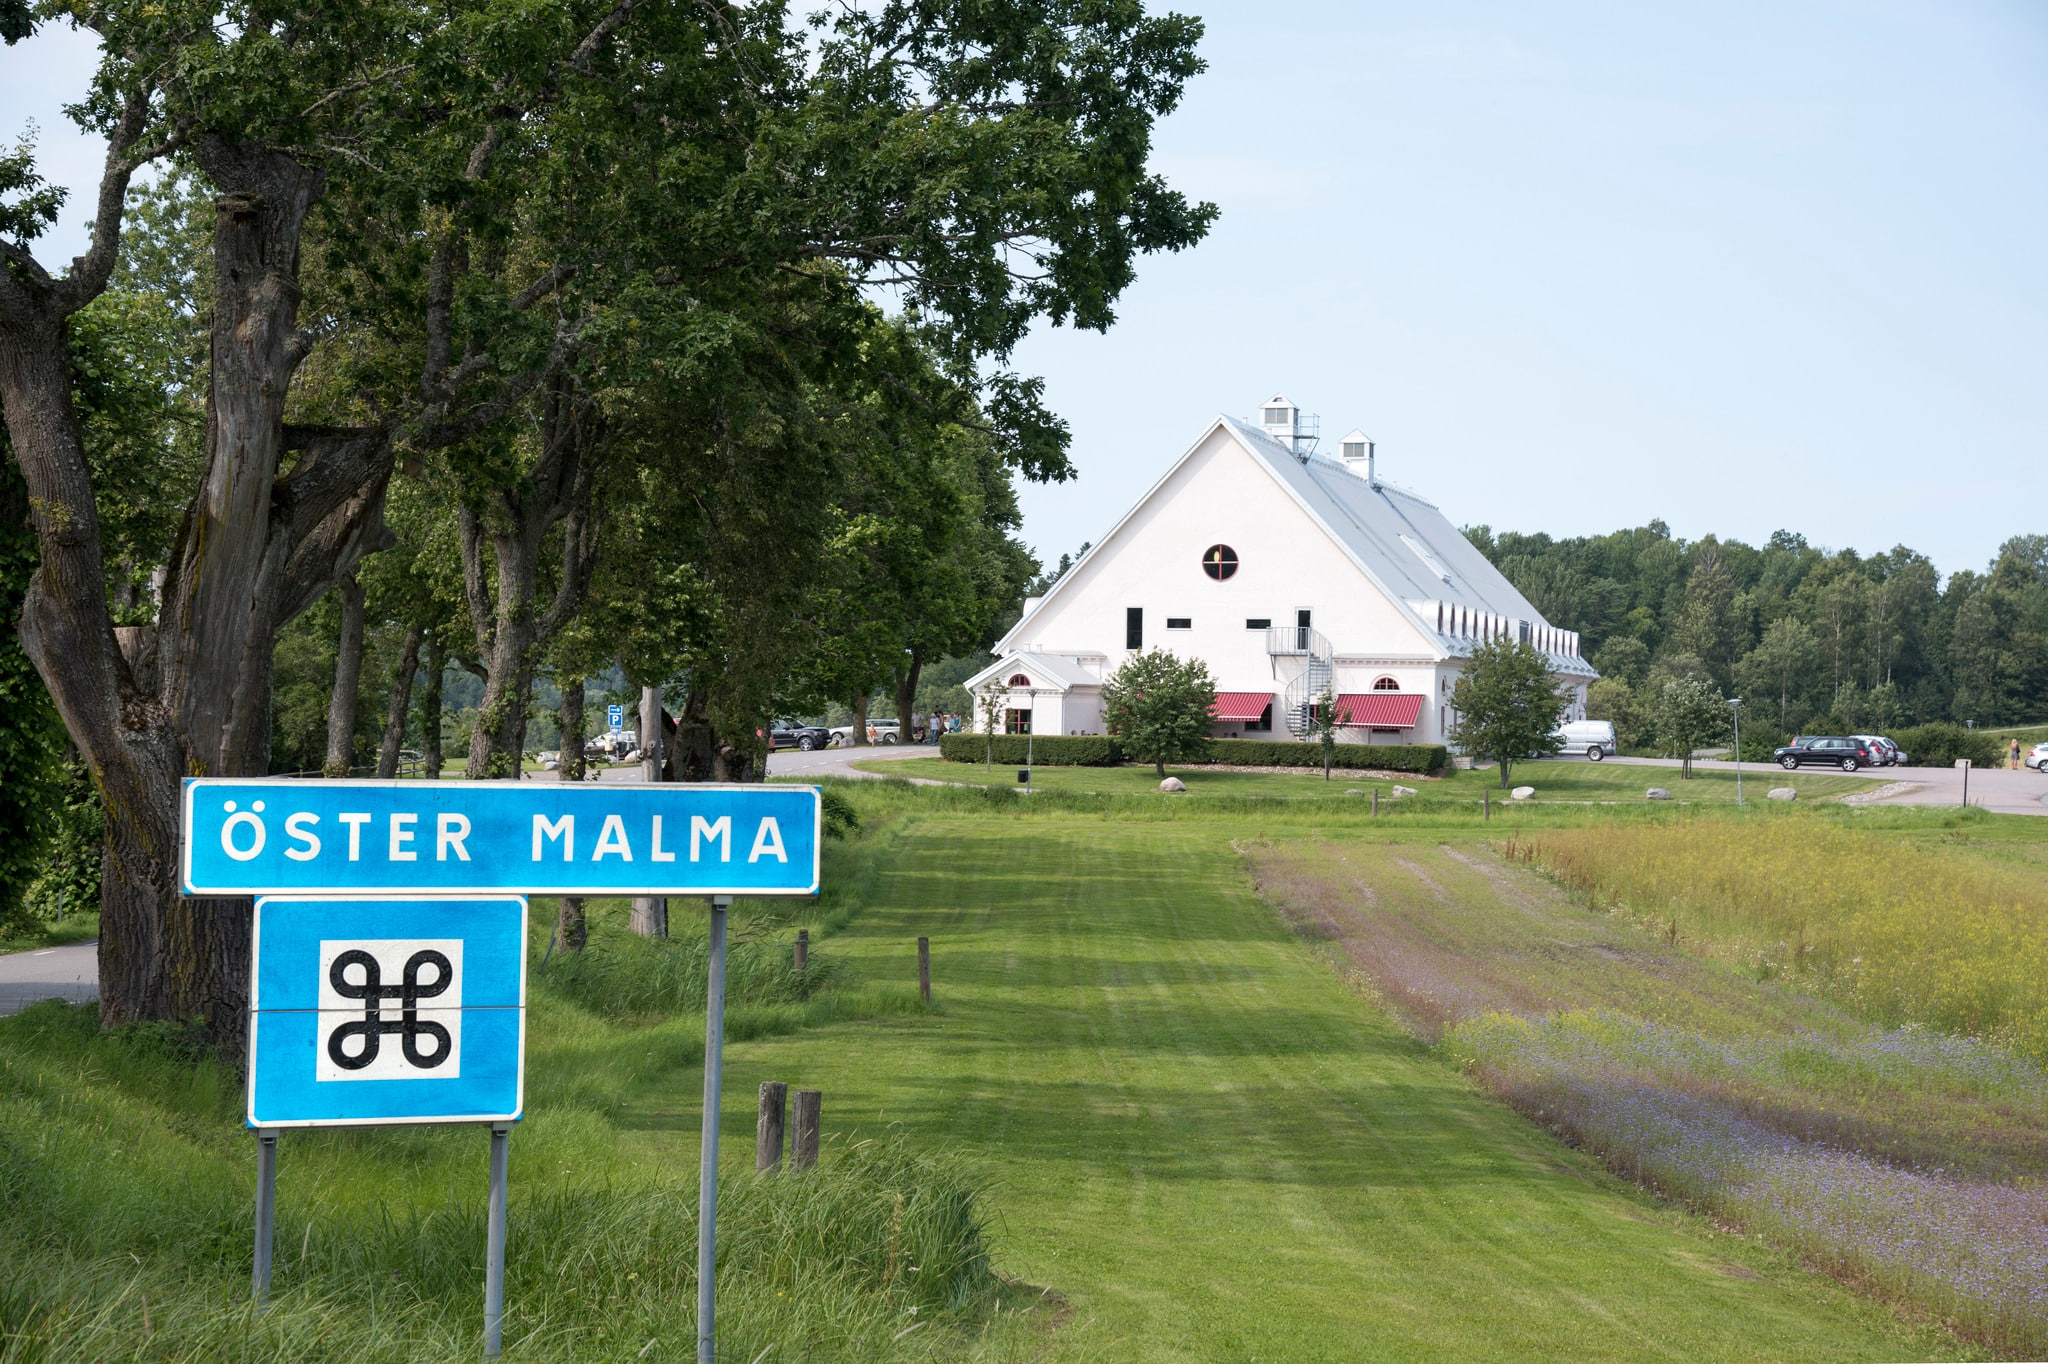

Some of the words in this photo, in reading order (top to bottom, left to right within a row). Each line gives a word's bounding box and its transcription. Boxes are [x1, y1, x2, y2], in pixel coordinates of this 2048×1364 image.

[612, 715, 619, 725] P
[220, 800, 472, 863] ÖSTER
[531, 813, 788, 863] MALMA
